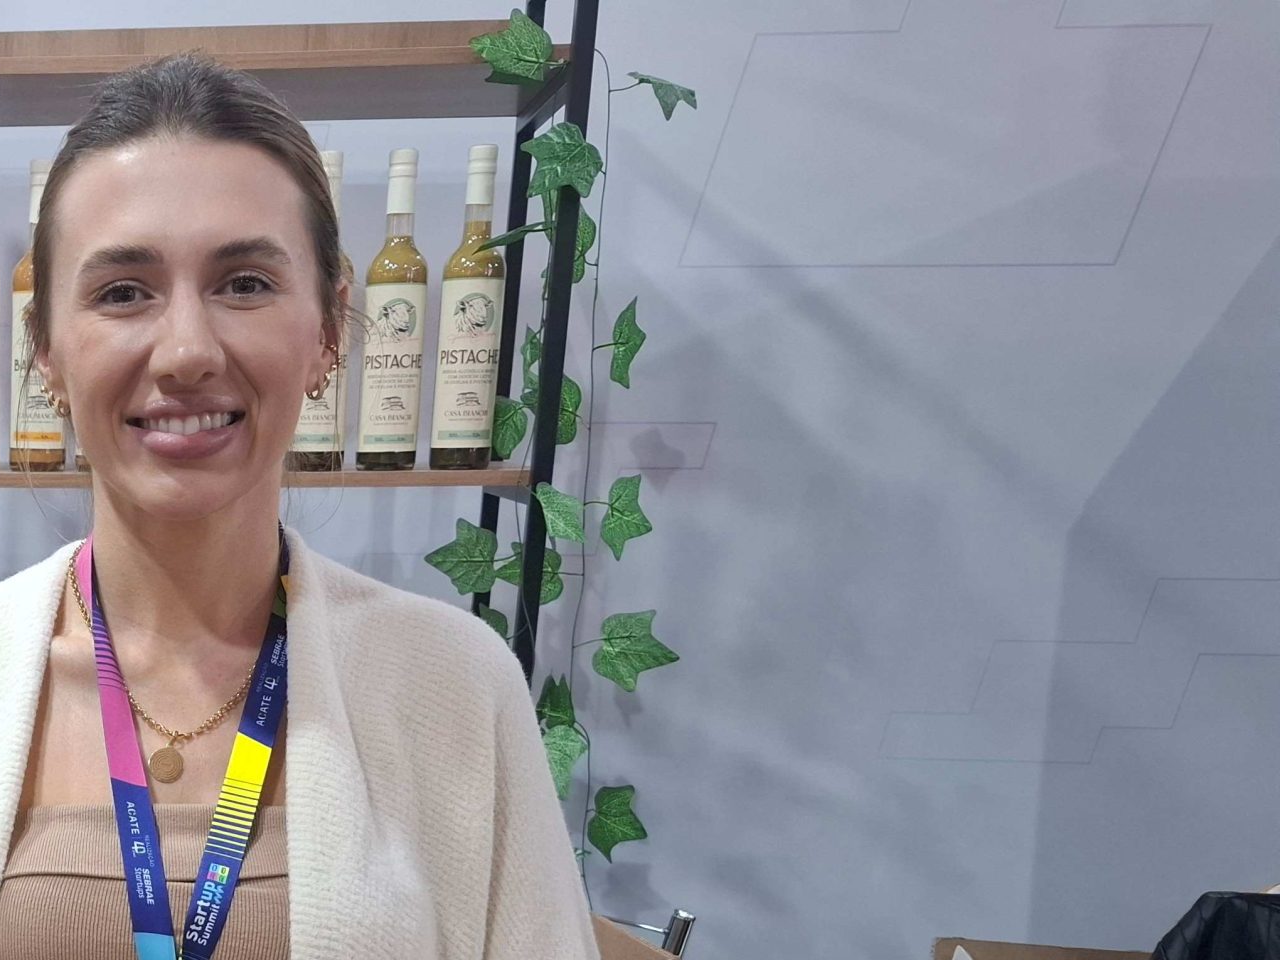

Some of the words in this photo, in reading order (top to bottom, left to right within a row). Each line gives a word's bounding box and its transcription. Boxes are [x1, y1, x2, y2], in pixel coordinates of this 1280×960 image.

[365, 354, 422, 370] PISTACHE
[440, 349, 498, 365] PISTACHE
[271, 634, 285, 665] SEBRAE
[256, 695, 271, 726] ACATE
[126, 801, 140, 834] ACATE
[135, 867, 144, 898] Startups
[142, 868, 154, 905] SEBRAE
[186, 881, 215, 942] Startup
[198, 904, 220, 946] Summit
